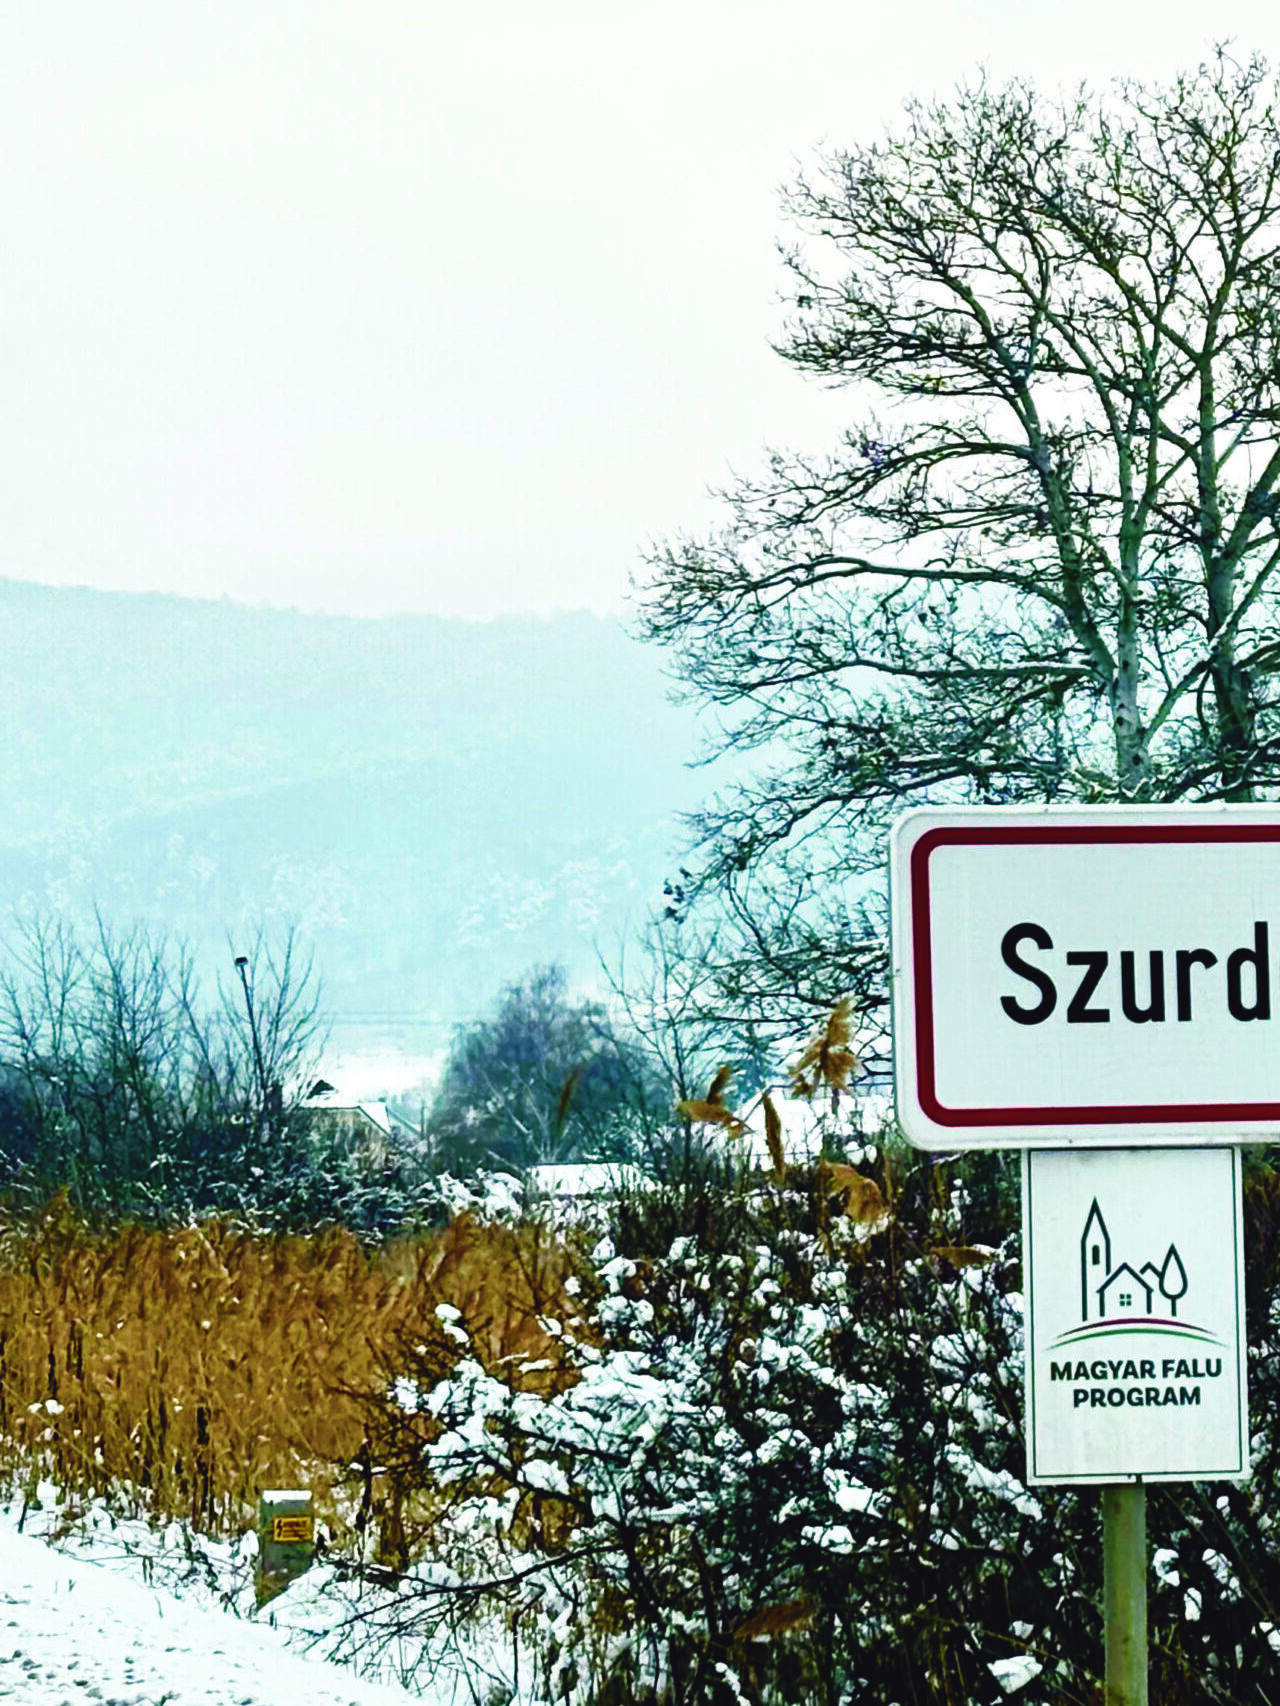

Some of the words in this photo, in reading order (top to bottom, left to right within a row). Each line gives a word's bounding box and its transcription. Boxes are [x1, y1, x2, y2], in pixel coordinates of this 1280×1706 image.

[1051, 1360, 1156, 1381] MAGYAR
[1163, 1359, 1221, 1378] FALU
[1074, 1387, 1200, 1407] PROGRAM
